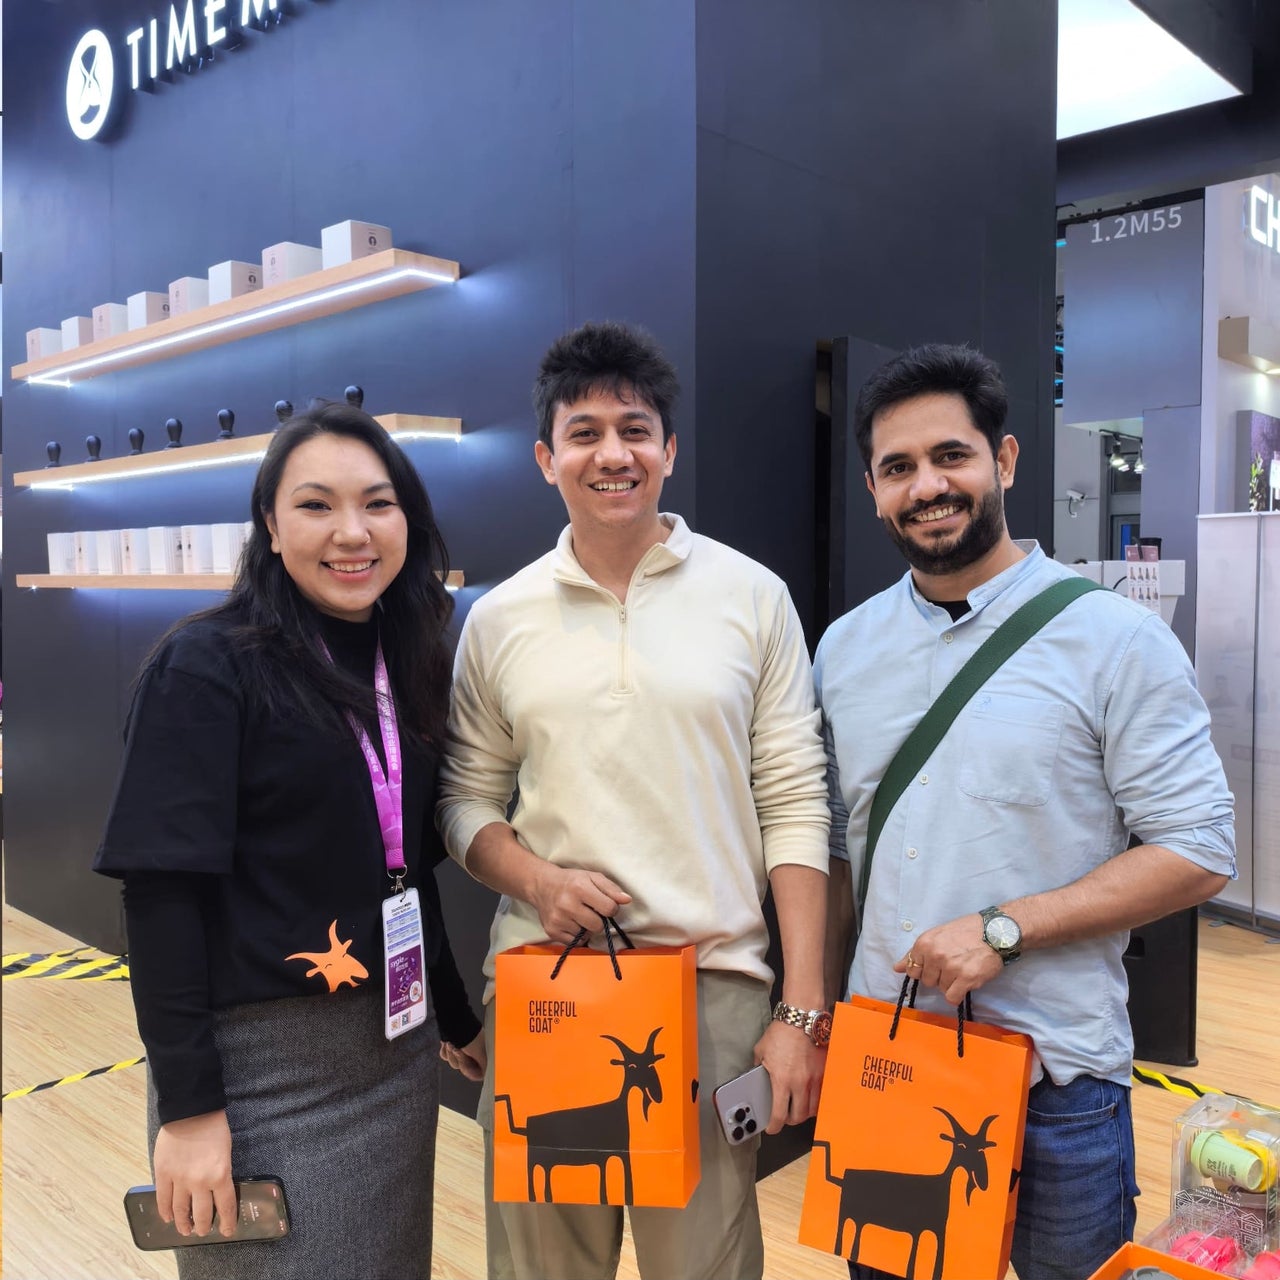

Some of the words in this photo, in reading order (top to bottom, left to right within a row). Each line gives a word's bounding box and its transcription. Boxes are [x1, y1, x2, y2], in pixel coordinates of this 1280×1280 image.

[1090, 206, 1183, 244] 1.2M55
[528, 1000, 578, 1018] CHEERFUL
[863, 1054, 914, 1084] CHEERFUL
